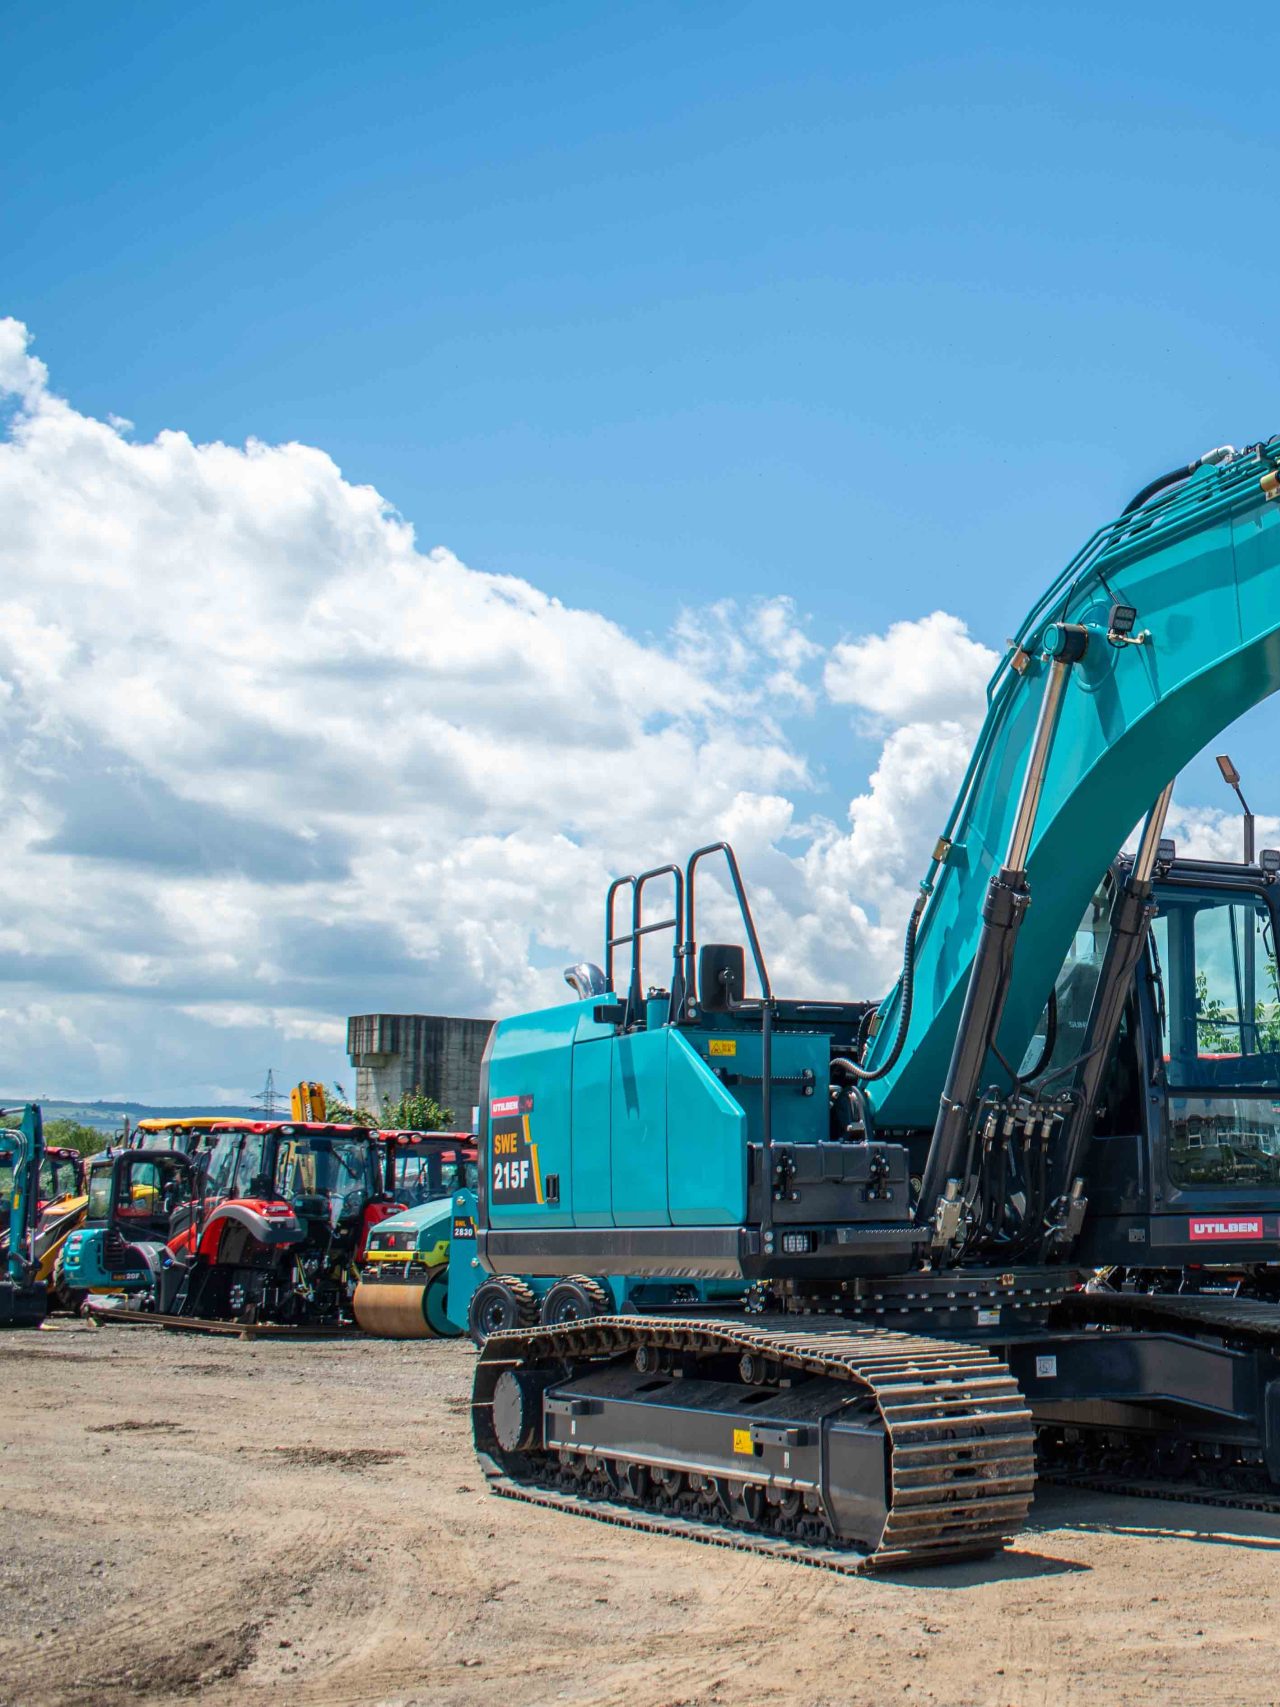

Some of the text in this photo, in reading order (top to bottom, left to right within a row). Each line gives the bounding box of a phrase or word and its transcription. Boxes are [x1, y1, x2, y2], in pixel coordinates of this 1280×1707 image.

[494, 1132, 518, 1155] SWE
[494, 1160, 529, 1190] 215F
[454, 1227, 473, 1237] 2830
[1194, 1222, 1259, 1234] UTILBEN
